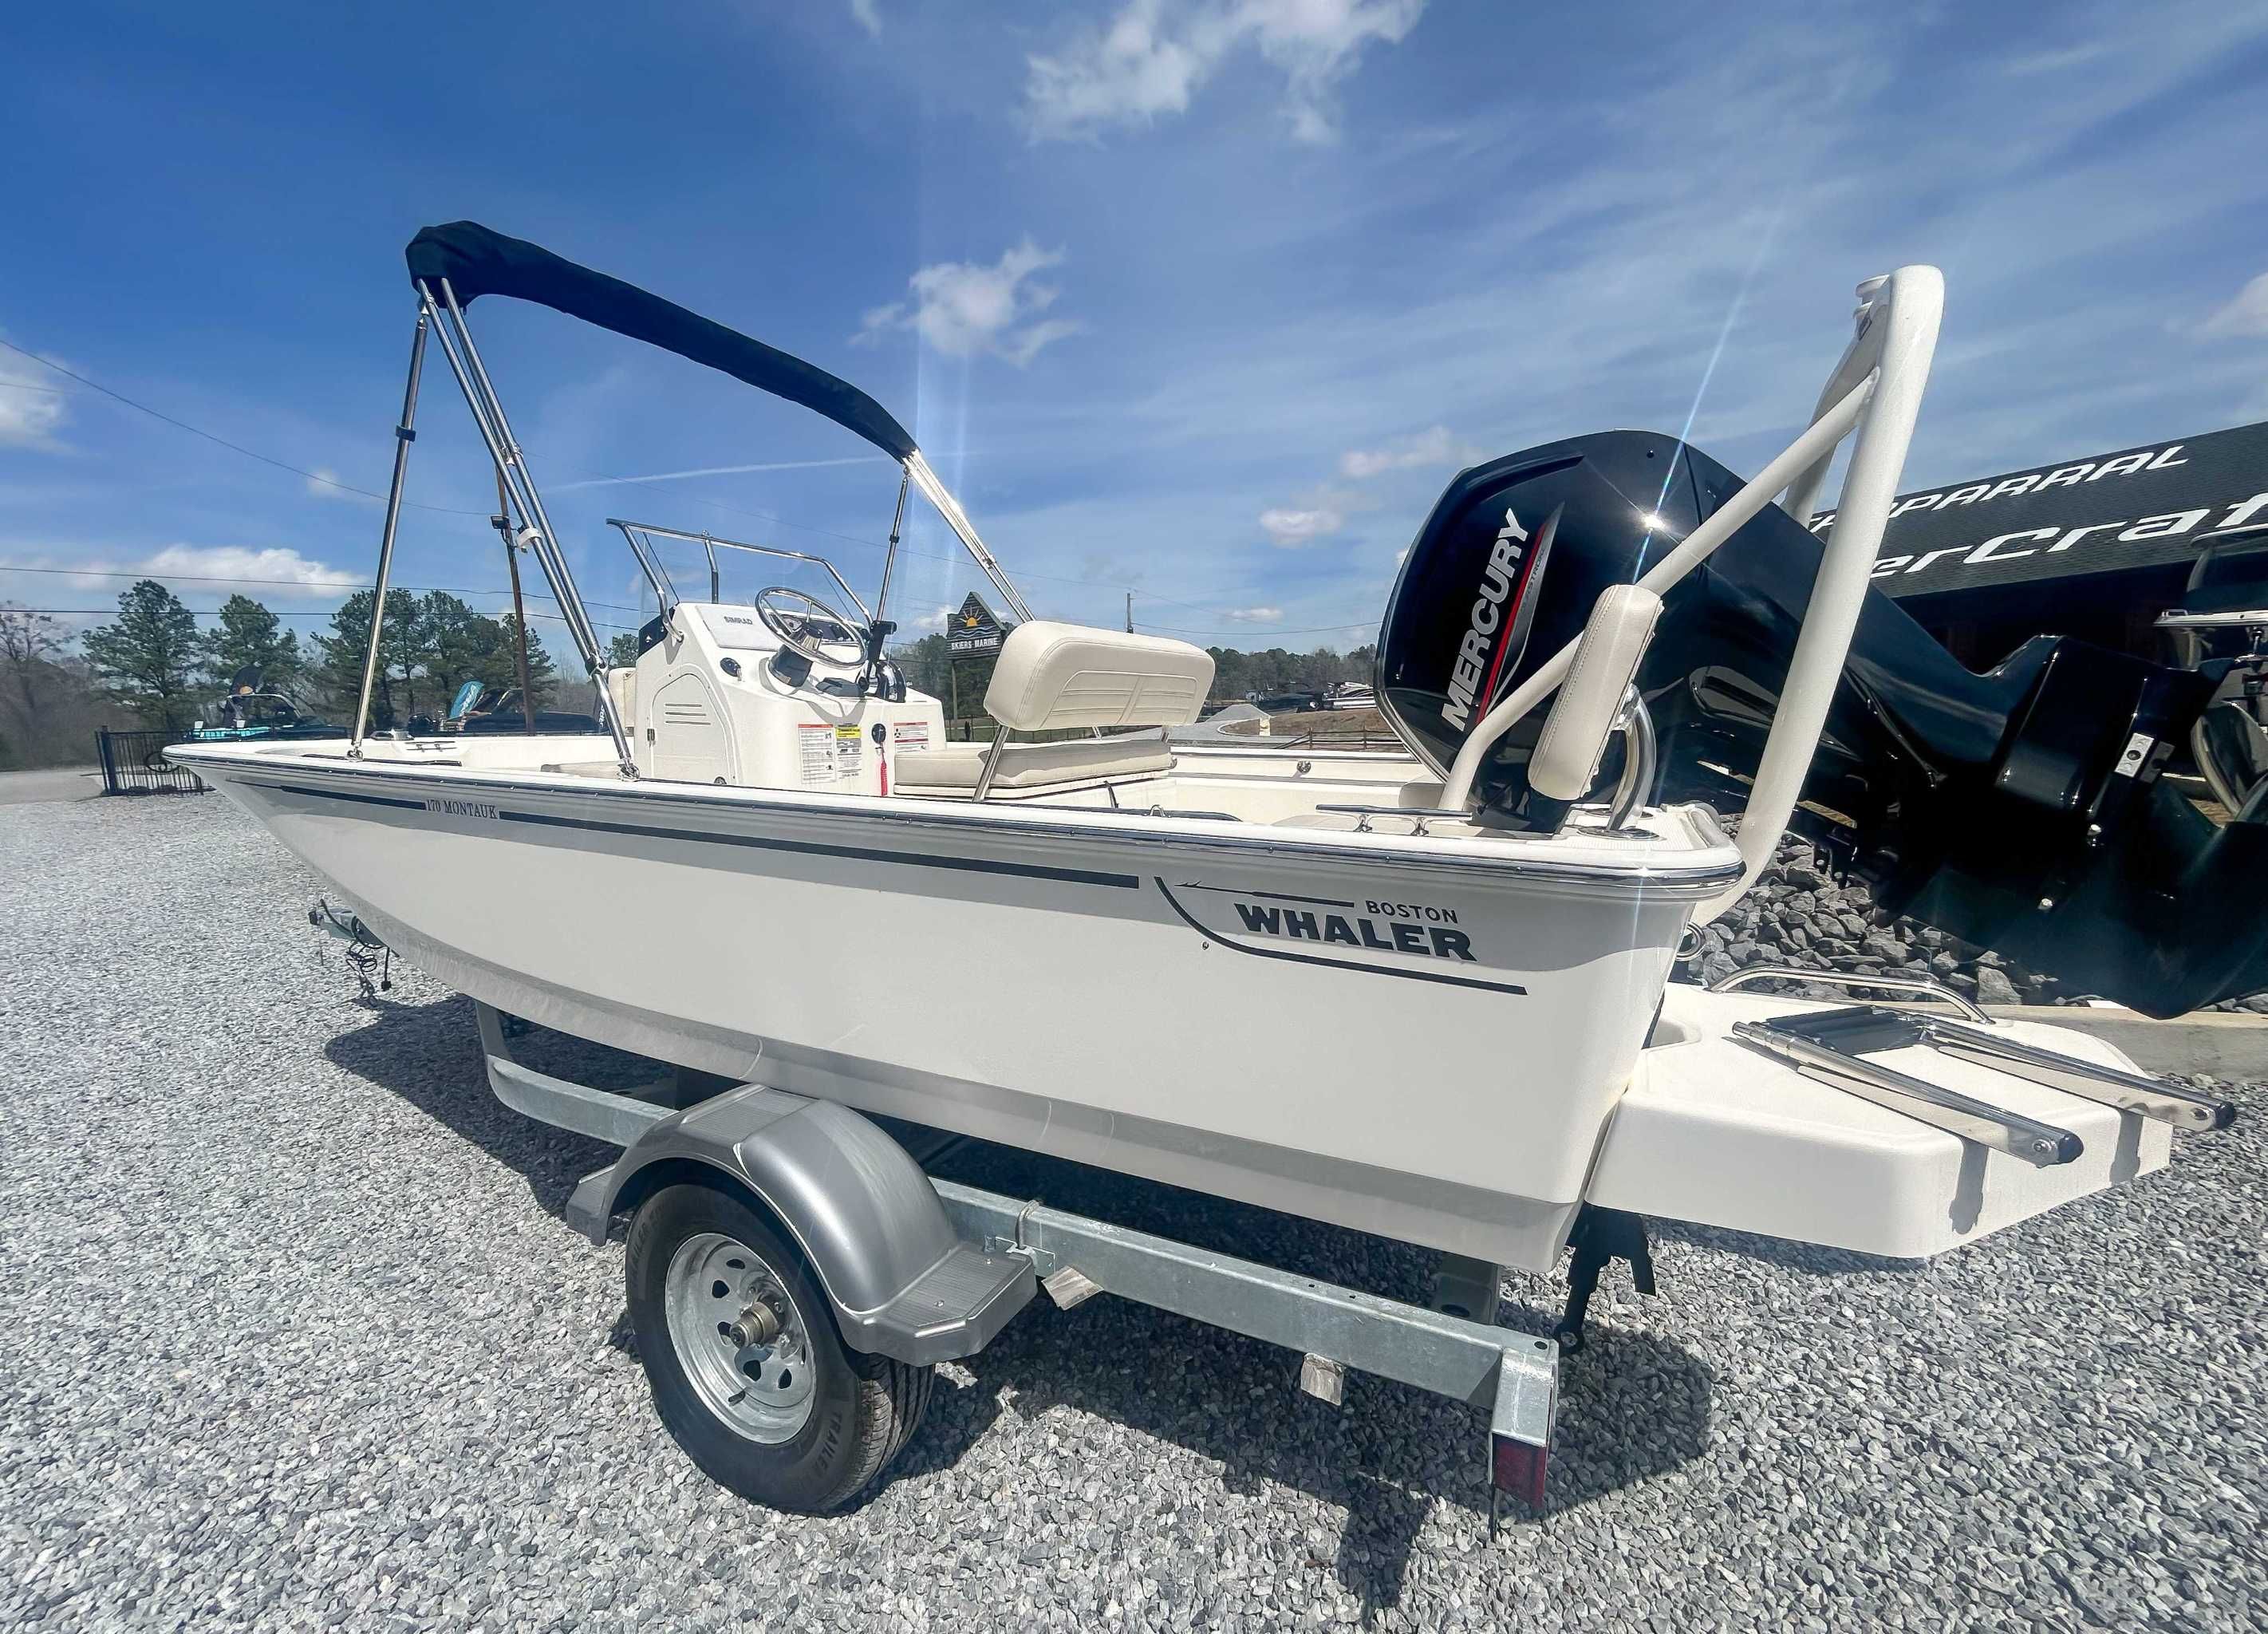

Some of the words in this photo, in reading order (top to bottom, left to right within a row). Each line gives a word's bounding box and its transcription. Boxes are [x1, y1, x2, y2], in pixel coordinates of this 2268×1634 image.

[1808, 445, 2189, 534] HPARRAL
[1441, 507, 1528, 732] MERCURY
[951, 641, 972, 650] SKIERS
[974, 637, 998, 648] MARINE
[427, 799, 441, 812] 170
[444, 799, 499, 819] MONTAUK
[1233, 903, 1477, 962] WHALER
[1365, 900, 1458, 925] BOSTON
